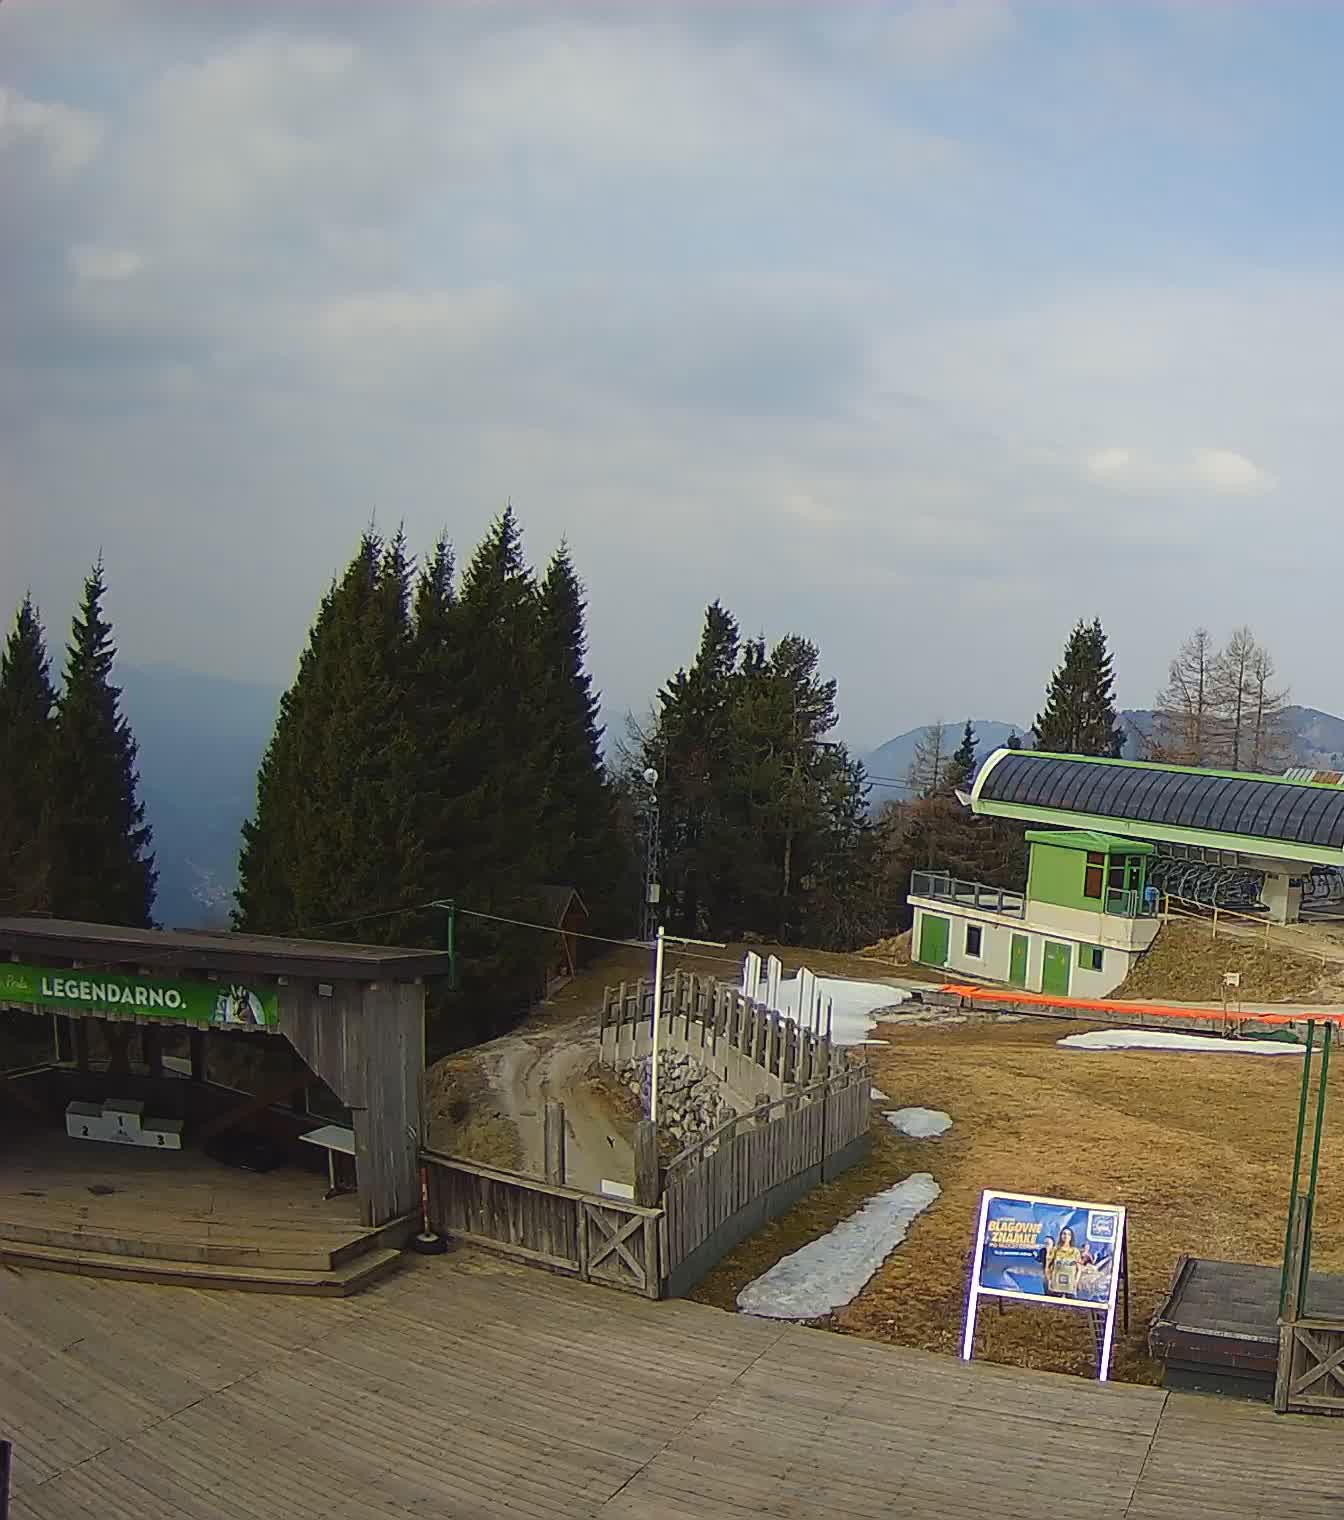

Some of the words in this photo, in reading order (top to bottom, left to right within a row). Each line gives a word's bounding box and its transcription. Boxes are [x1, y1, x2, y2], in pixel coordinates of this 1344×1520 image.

[41, 977, 187, 1009] LEGENDARNO.
[118, 1116, 123, 1126] 1
[82, 1126, 89, 1136] 2
[157, 1135, 165, 1145] 3
